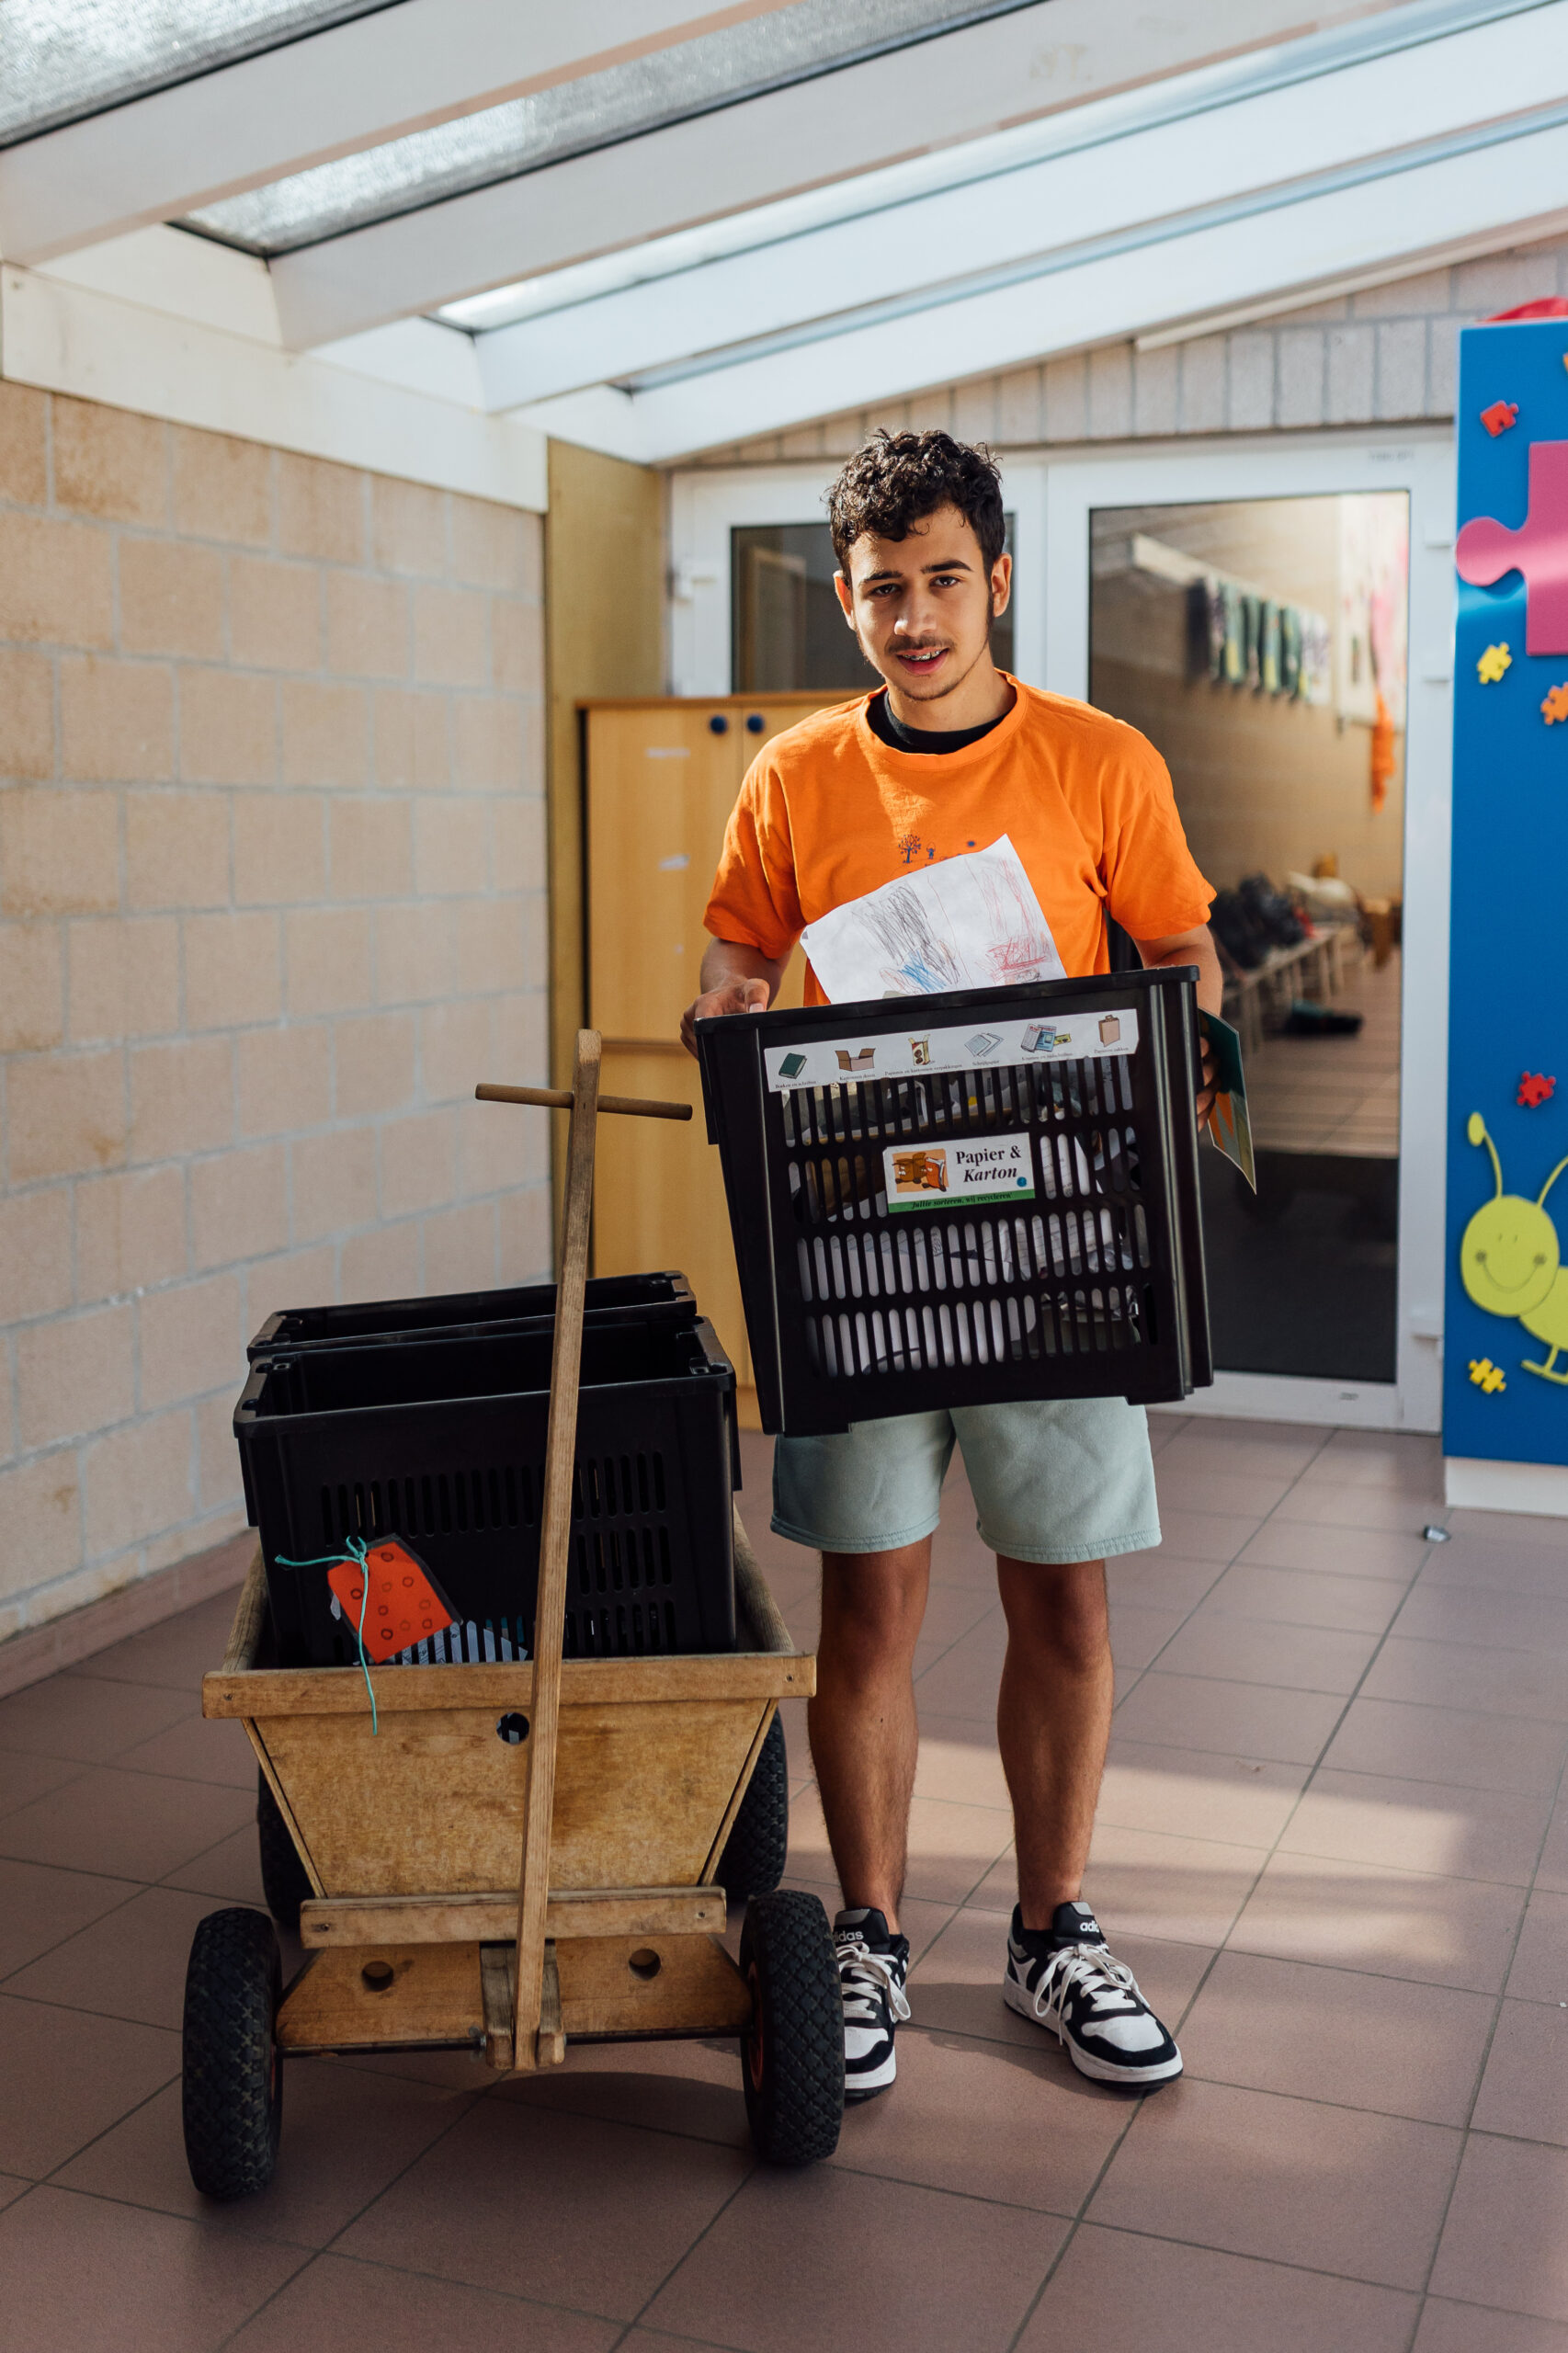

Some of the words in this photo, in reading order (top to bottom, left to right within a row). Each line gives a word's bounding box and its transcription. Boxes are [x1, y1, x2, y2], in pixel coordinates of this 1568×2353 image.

[956, 1147, 1006, 1166] Papier
[1010, 1144, 1022, 1159] &
[963, 1166, 1017, 1183] Karton
[912, 1199, 932, 1210] Jullie
[966, 1194, 976, 1204] wij
